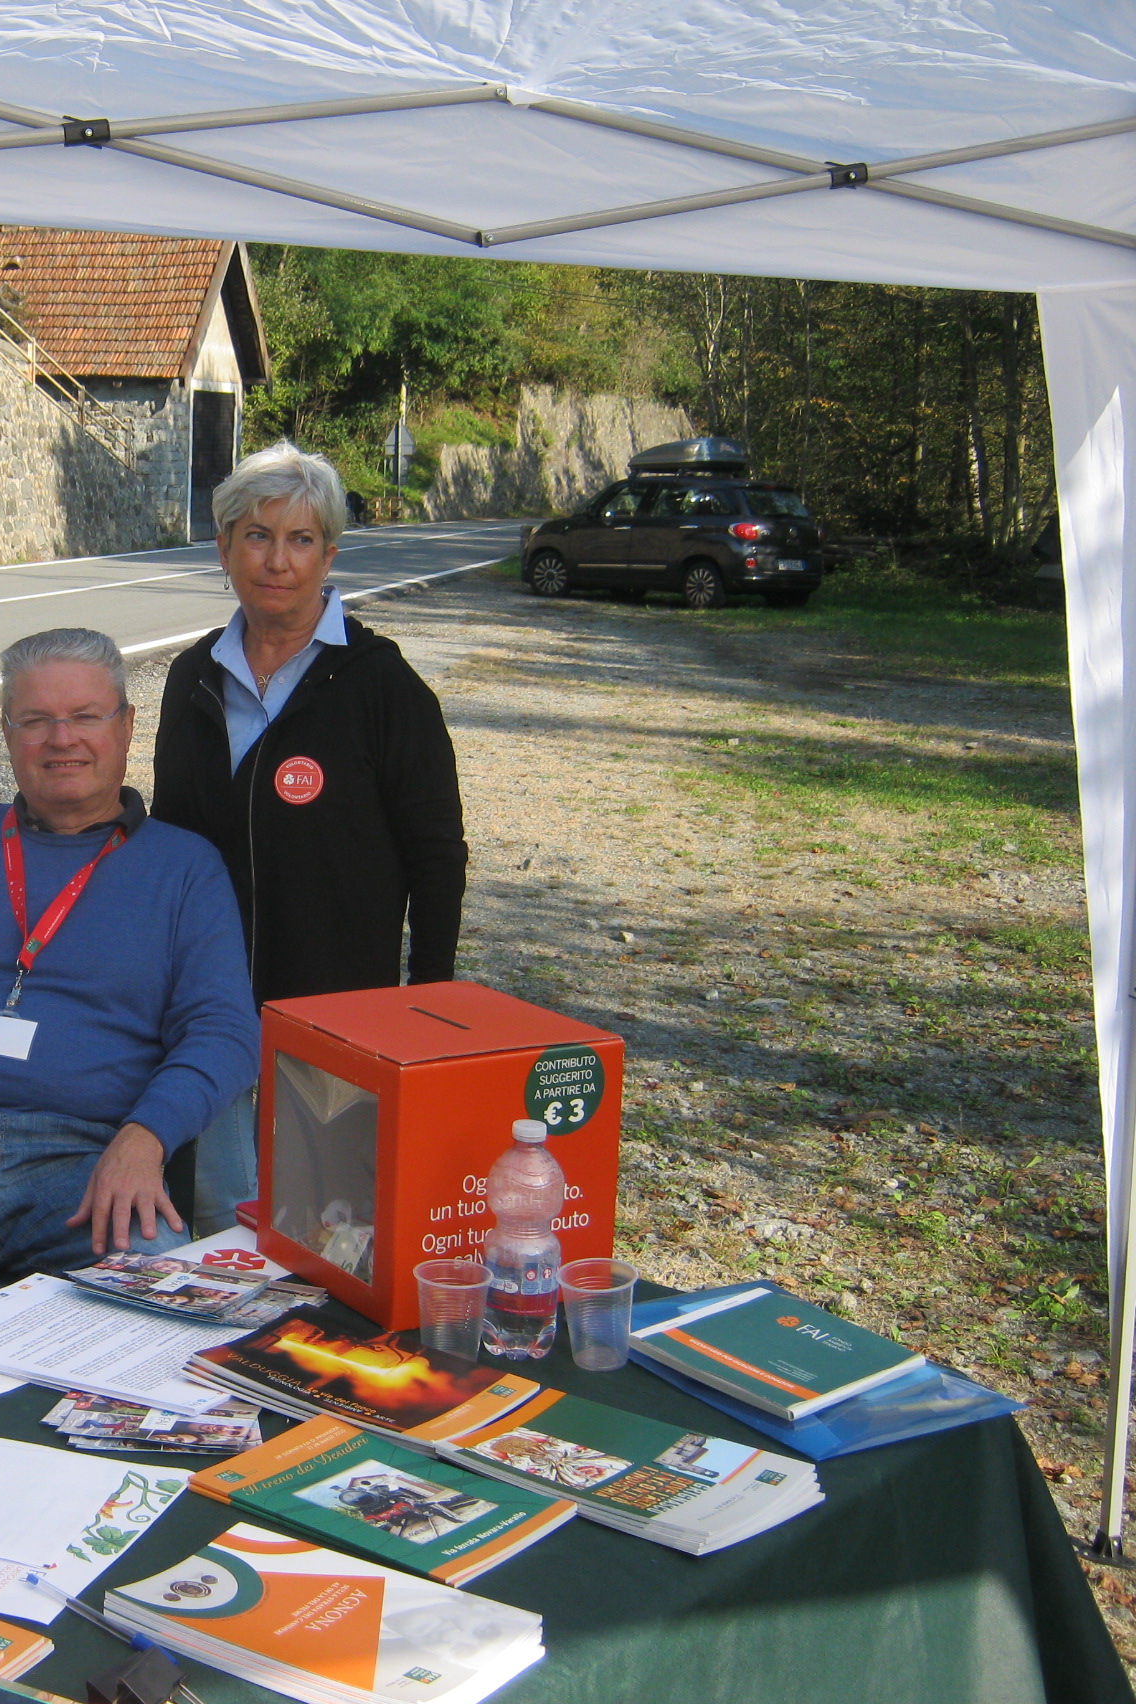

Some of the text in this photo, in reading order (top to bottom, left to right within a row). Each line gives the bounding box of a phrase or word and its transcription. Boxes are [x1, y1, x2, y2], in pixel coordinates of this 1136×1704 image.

[296, 774, 312, 786] FAI
[535, 1056, 596, 1072] CONTRIBUTO
[540, 1070, 592, 1086] SUGGERITO
[534, 1083, 596, 1100] A PARTIRE DA
[544, 1098, 584, 1126] € 3
[463, 1174, 487, 1195] Og
[430, 1206, 452, 1222] un
[458, 1200, 486, 1217] tuo
[564, 1184, 584, 1200] to.
[422, 1230, 462, 1254] Ogni
[796, 1324, 830, 1340] FAI
[228, 1352, 302, 1387] VALDUGGIA
[260, 1474, 294, 1488] treno
[297, 1462, 315, 1476] dei
[315, 1436, 368, 1464] Desideri
[646, 1482, 711, 1514] GRIGNASCO
[305, 1588, 368, 1632] AGNONA
